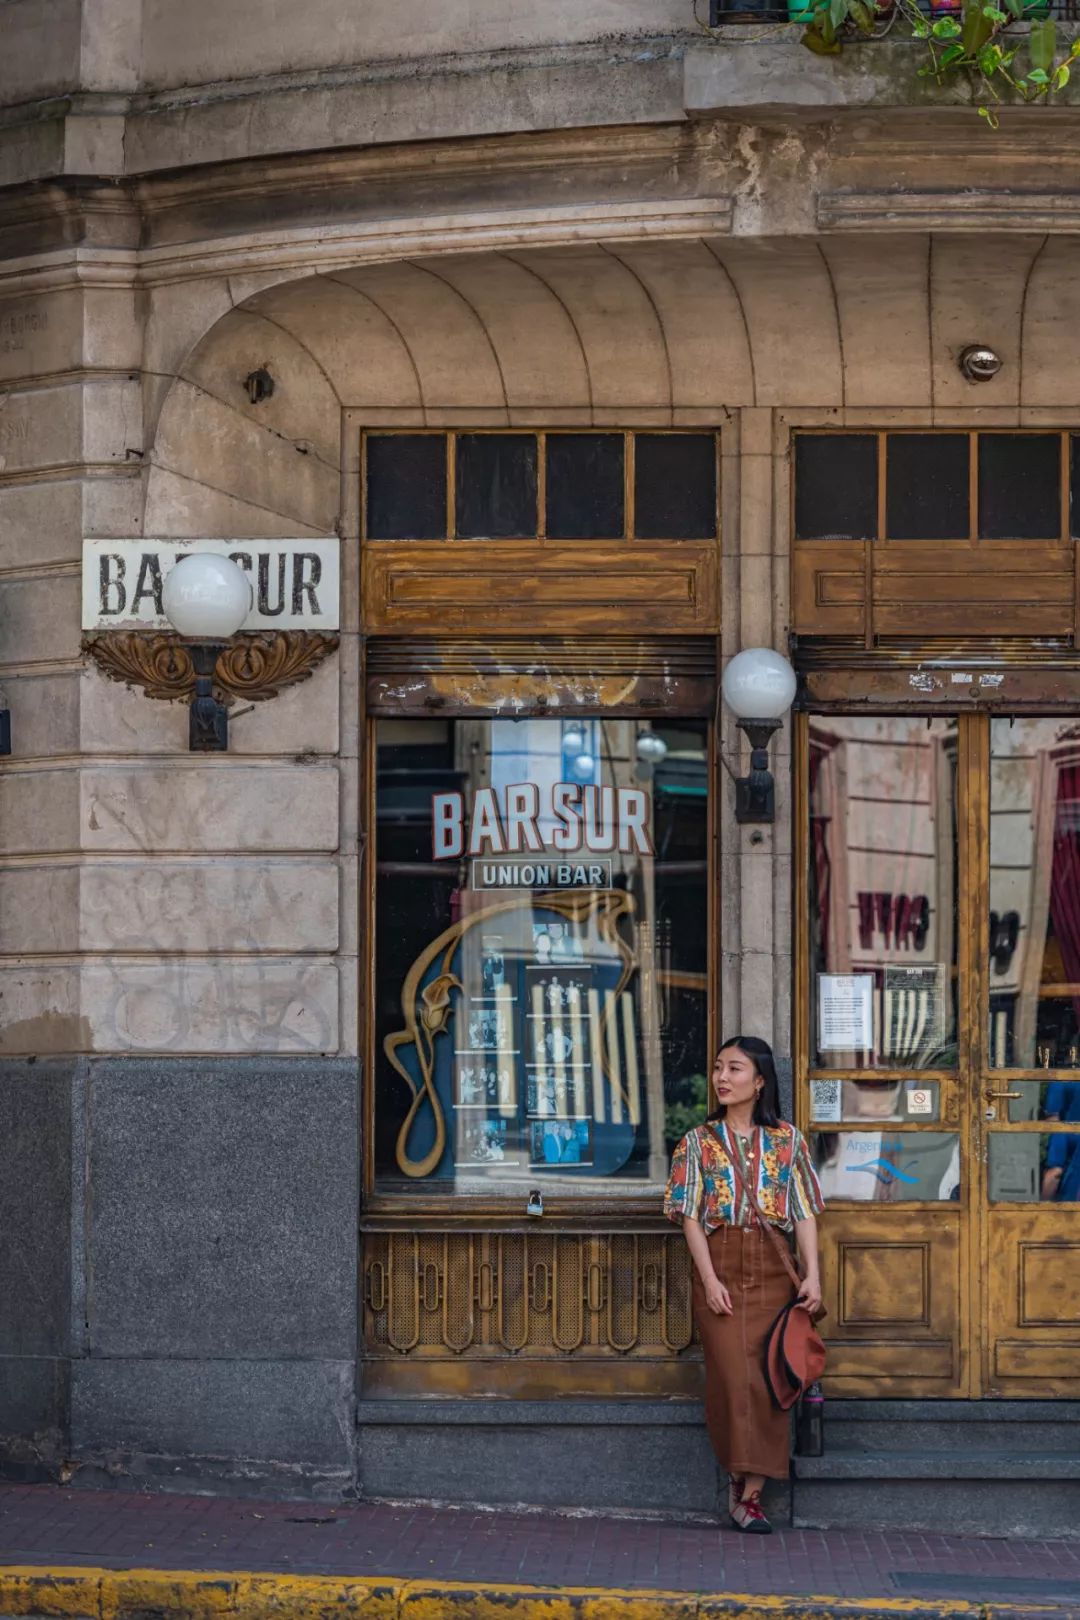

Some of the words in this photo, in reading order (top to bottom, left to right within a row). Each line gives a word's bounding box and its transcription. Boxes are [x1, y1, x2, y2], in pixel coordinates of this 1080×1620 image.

[98, 552, 195, 616] BA
[432, 784, 545, 860] BAR
[552, 782, 654, 855] SUR
[483, 865, 549, 885] UNION
[557, 865, 602, 885] BAR
